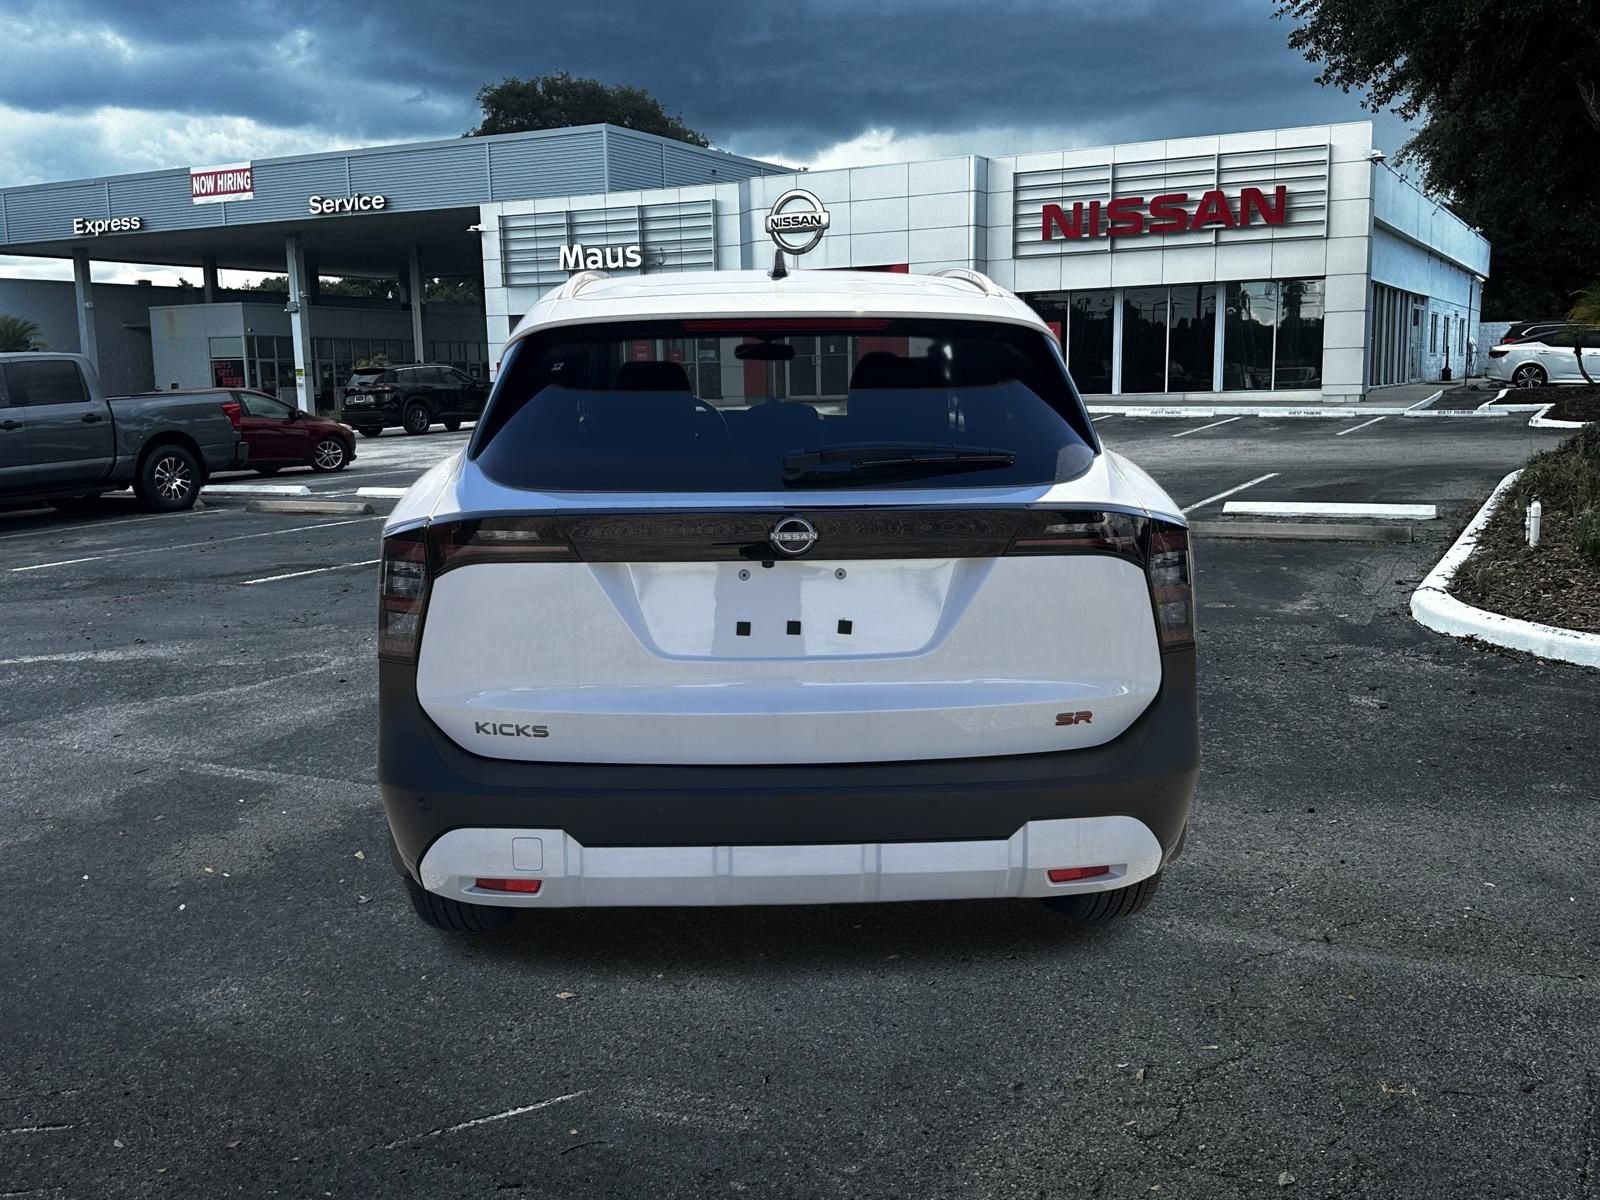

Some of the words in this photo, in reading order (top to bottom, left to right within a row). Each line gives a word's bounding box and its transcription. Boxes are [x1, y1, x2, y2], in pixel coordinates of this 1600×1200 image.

[193, 175, 215, 195] NOW
[217, 171, 251, 192] HIRING
[309, 193, 385, 215] Service
[1042, 185, 1287, 241] NISSAN
[73, 216, 141, 237] Express
[770, 215, 822, 229] NISSAN
[559, 244, 642, 270] Maus
[222, 376, 244, 387] FREE
[1055, 711, 1093, 726] SR
[475, 721, 550, 738] KICKS
